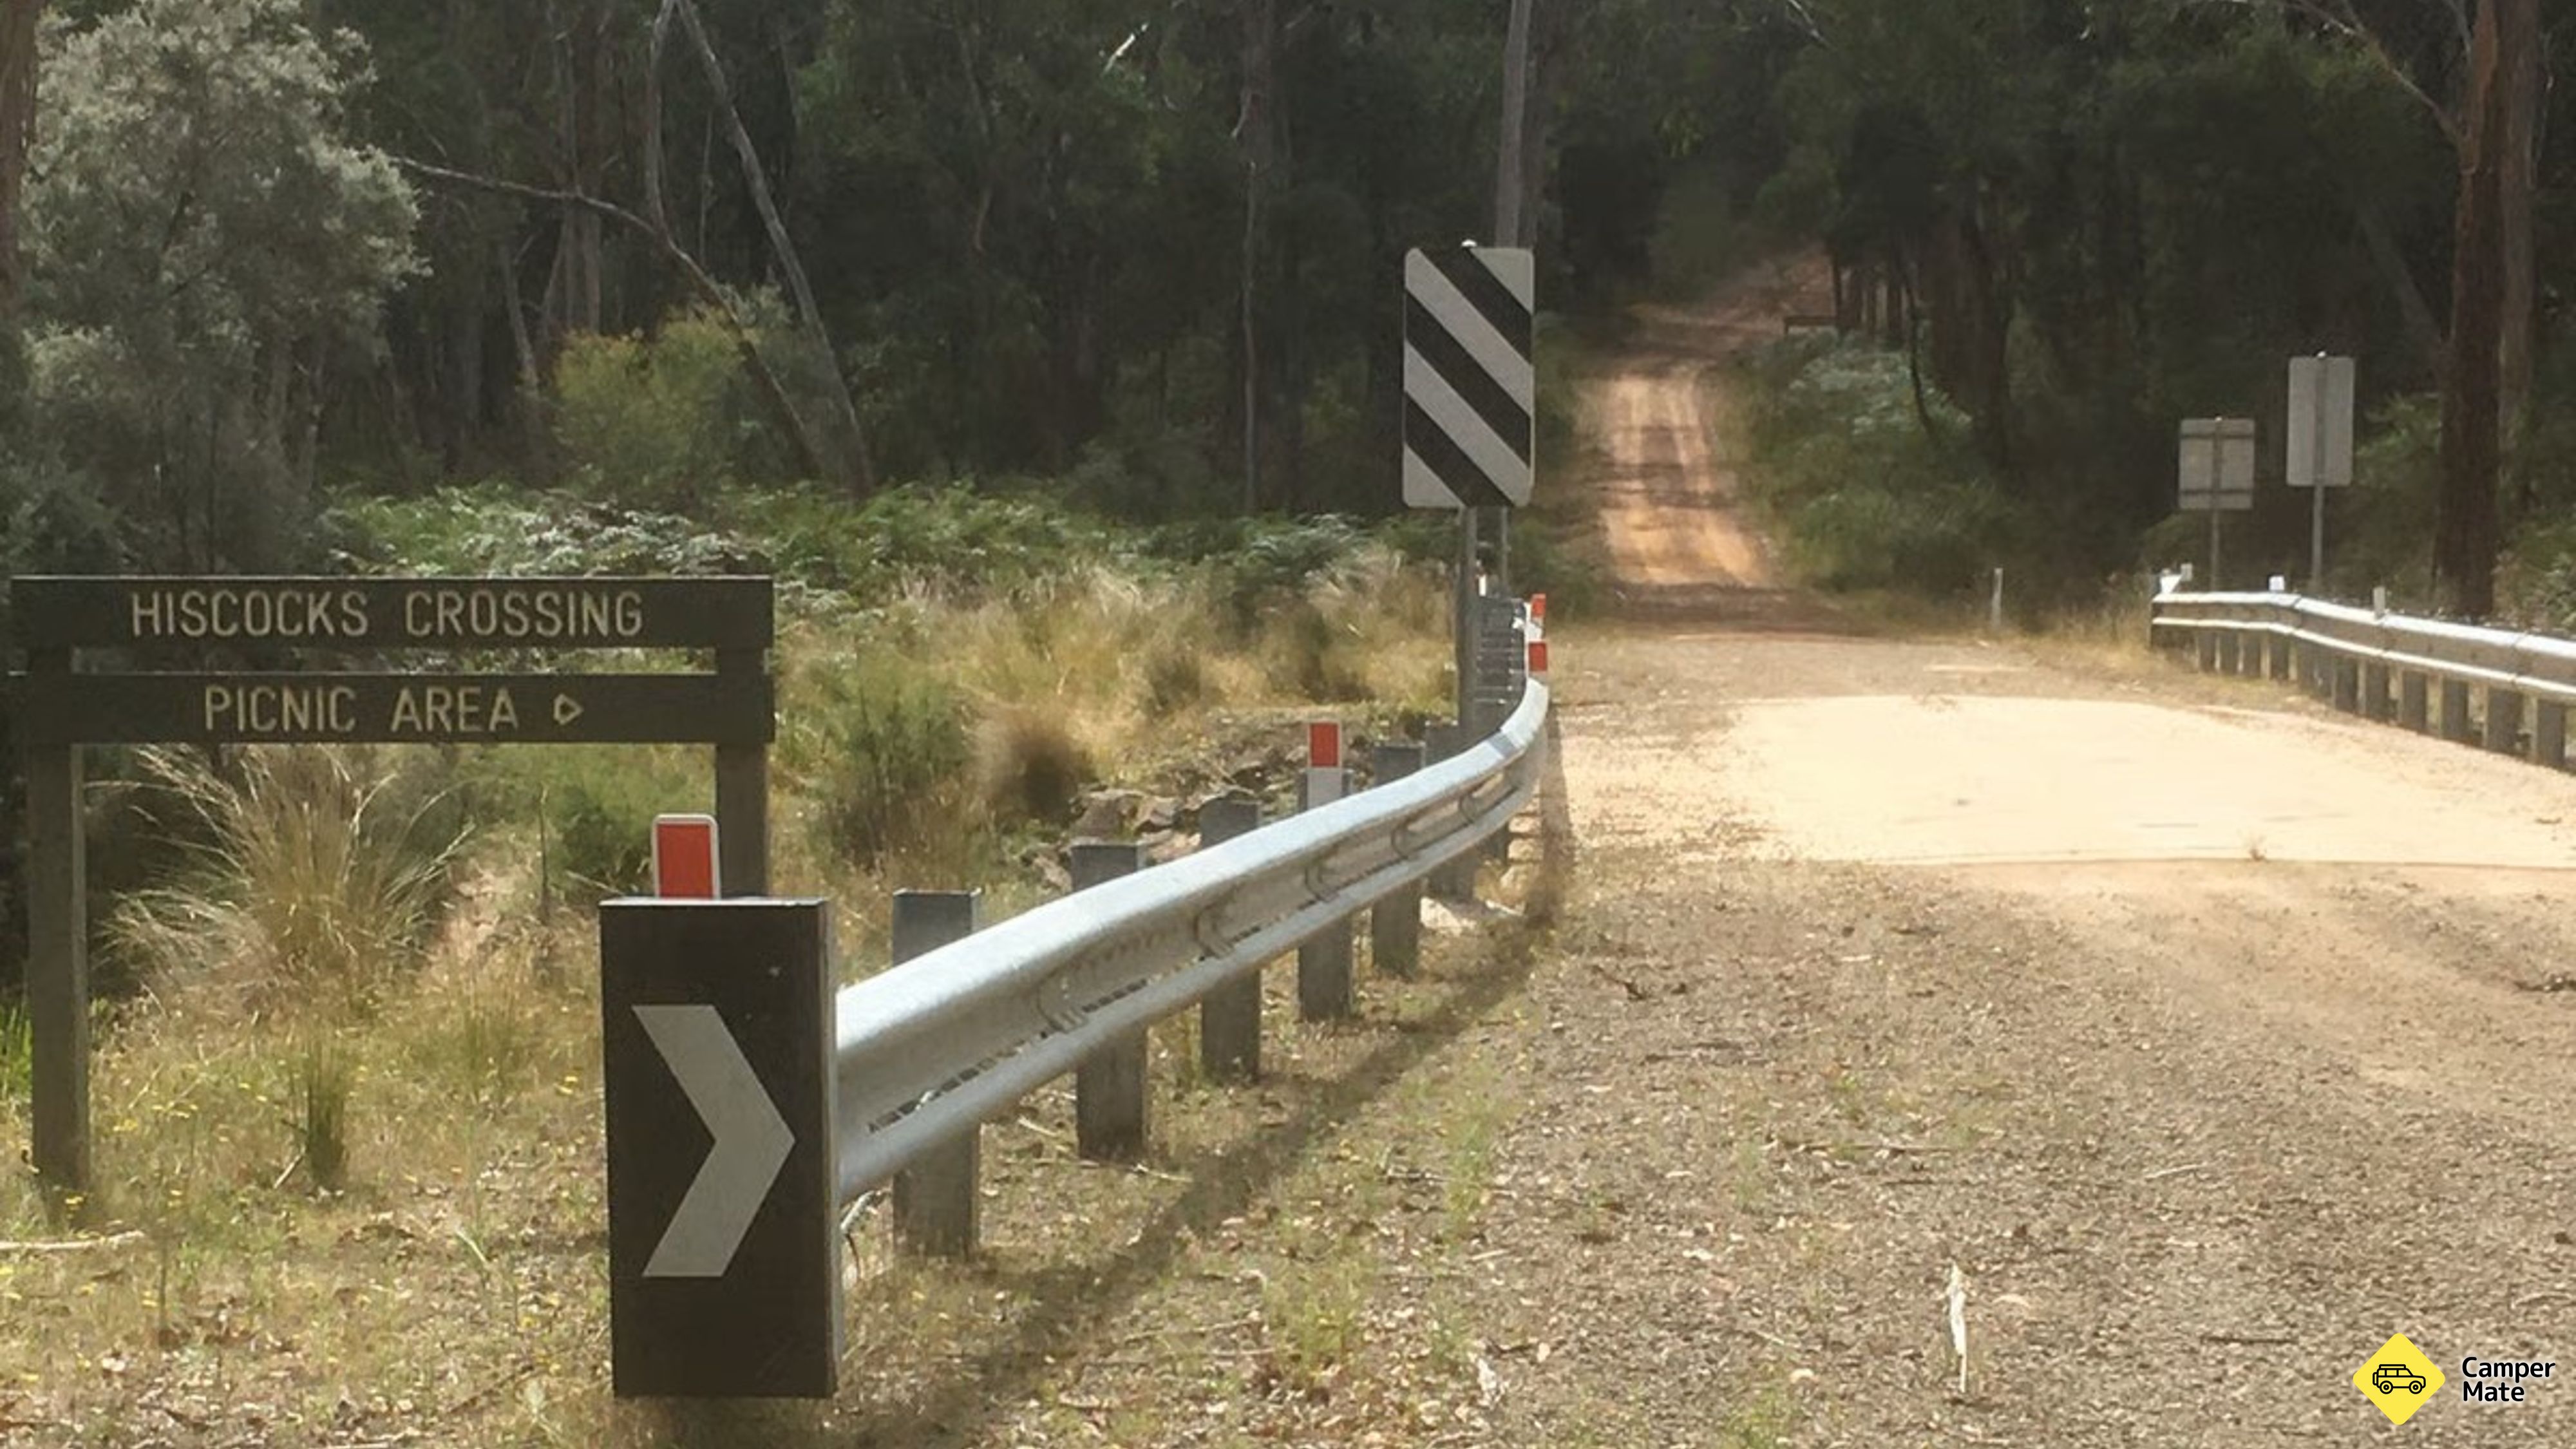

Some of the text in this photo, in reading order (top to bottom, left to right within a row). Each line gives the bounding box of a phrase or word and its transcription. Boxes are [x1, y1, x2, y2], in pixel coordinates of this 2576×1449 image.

[131, 591, 643, 636] HISCOCKS CROSSING
[205, 687, 516, 732] PICNIC AREA
